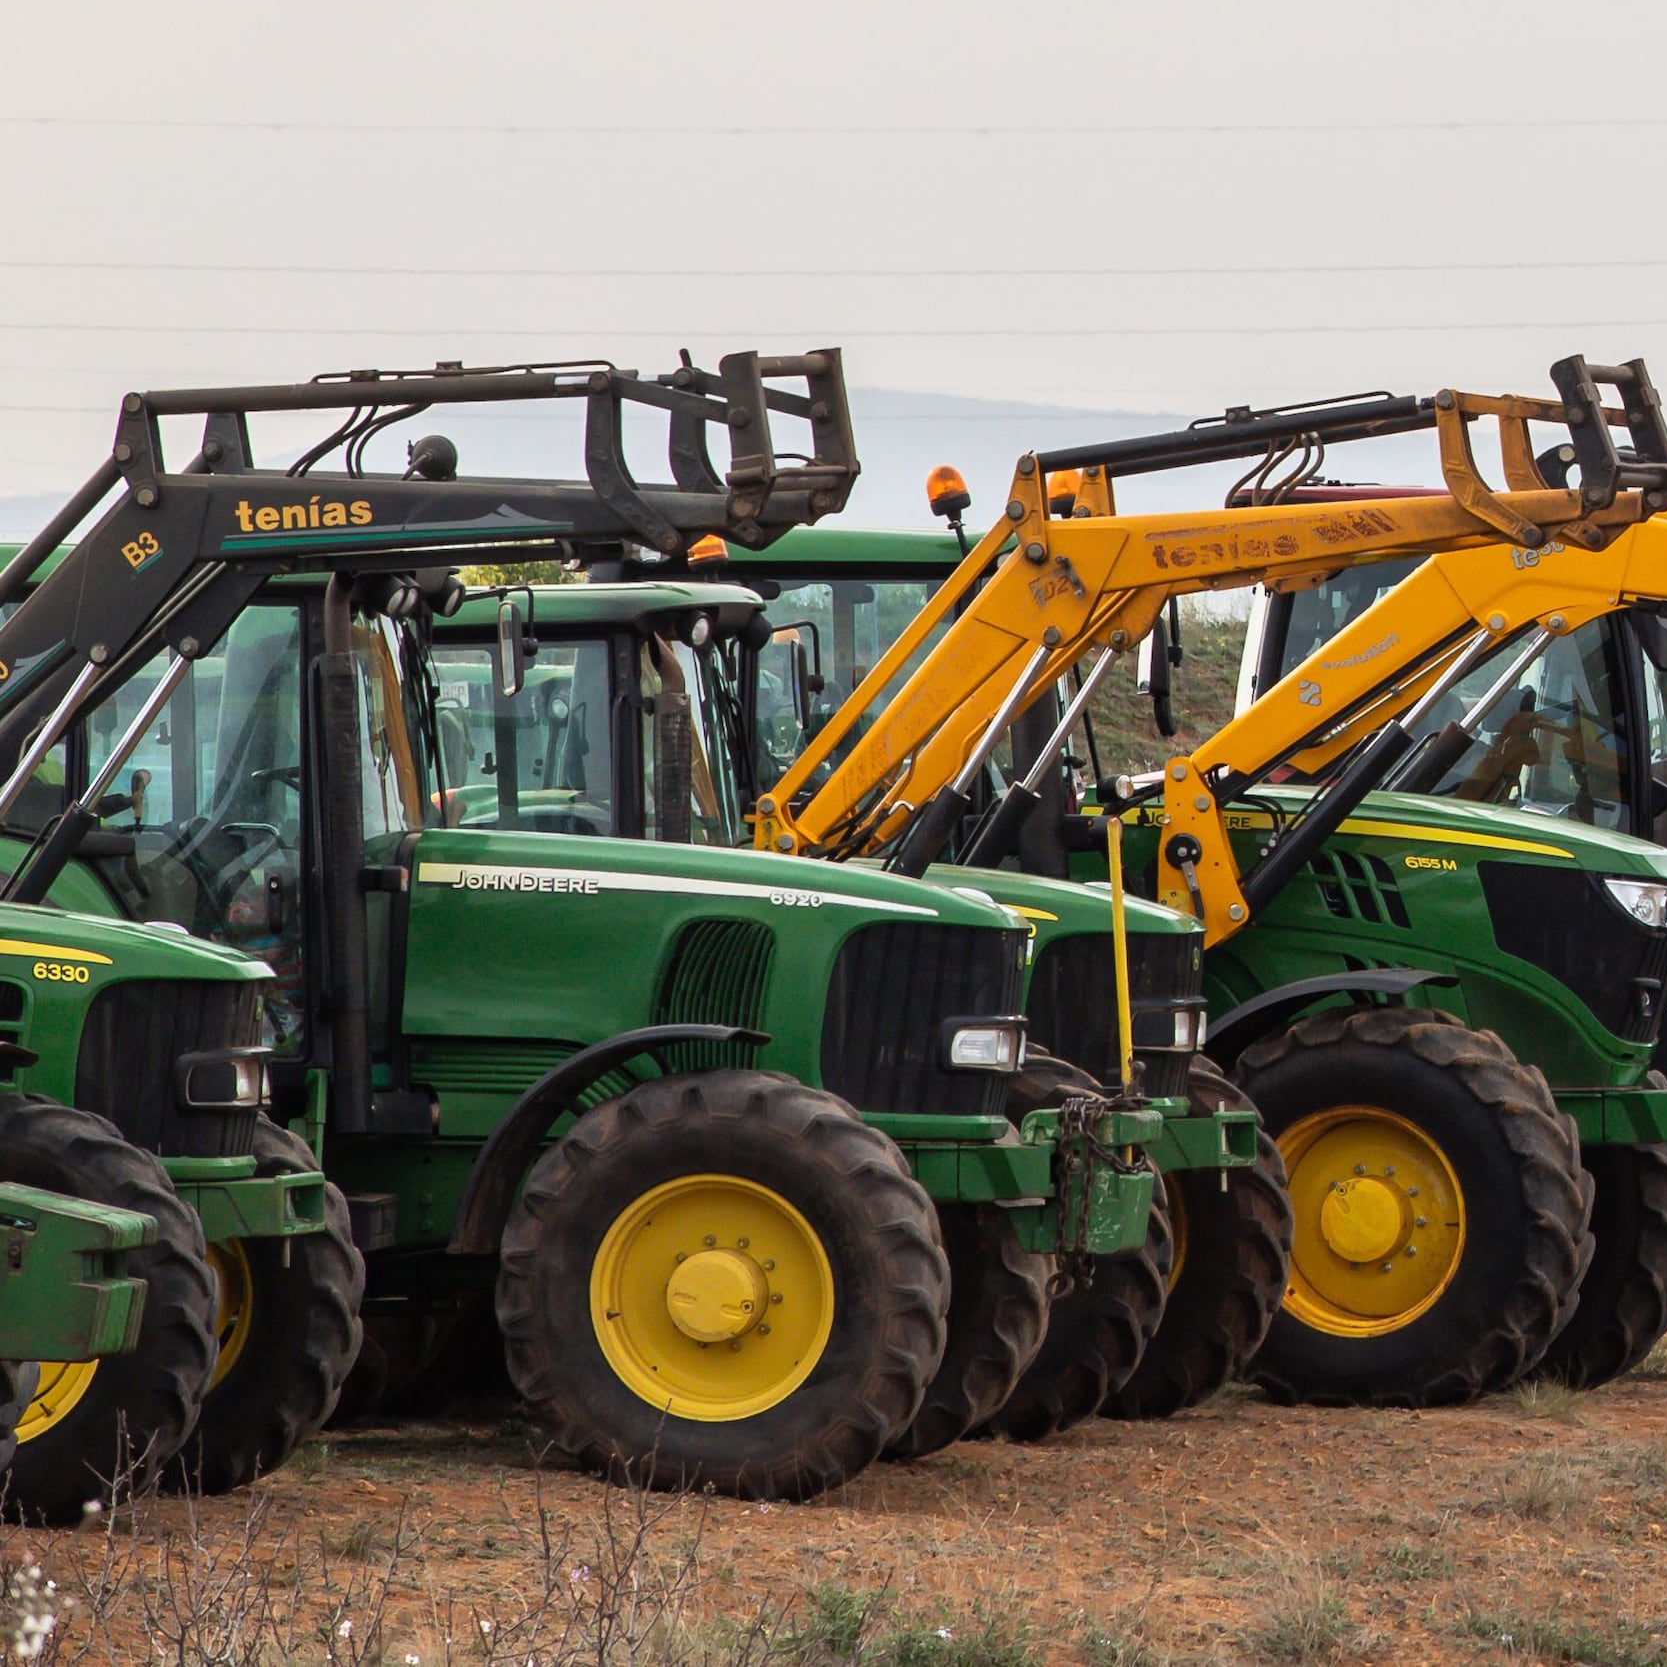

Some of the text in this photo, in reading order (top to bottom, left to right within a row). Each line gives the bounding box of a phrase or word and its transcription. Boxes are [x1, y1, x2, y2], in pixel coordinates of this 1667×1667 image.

[235, 495, 373, 532] tenías
[121, 532, 159, 568] B3
[1404, 856, 1458, 871] 6155 M
[452, 870, 600, 894] JOHN DEERE
[770, 891, 823, 908] 6920
[33, 962, 90, 984] 6330
